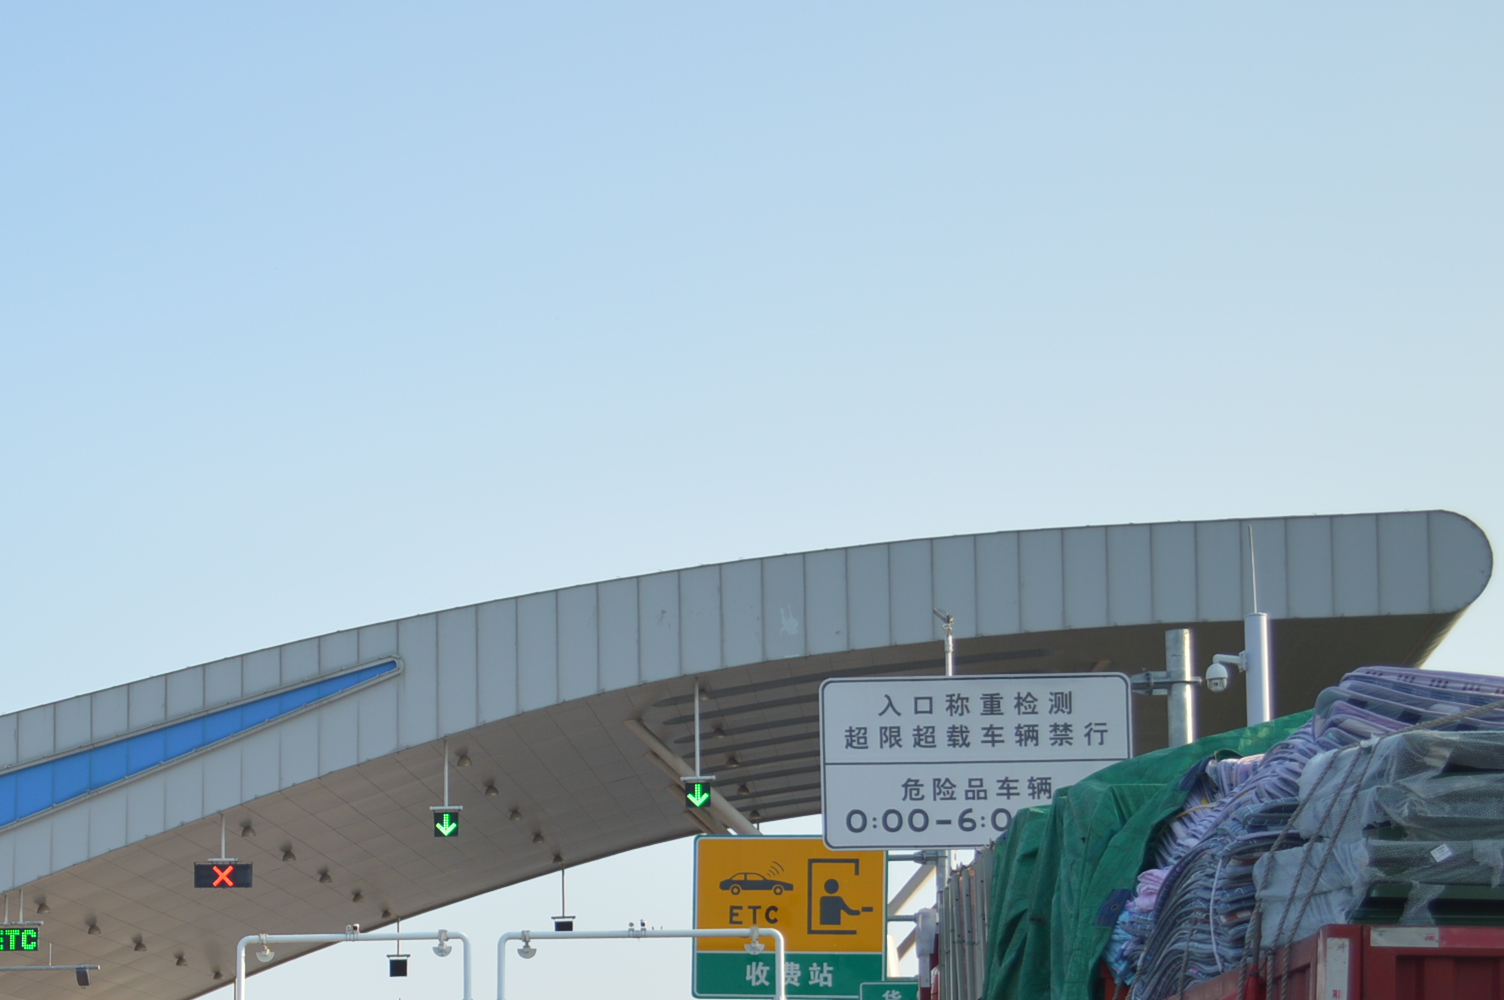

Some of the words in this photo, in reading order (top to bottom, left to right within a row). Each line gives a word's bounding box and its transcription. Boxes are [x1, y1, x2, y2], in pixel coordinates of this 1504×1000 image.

[877, 691, 1074, 717] 入口称重检测
[844, 721, 1110, 750] 超限超载车辆禁行
[901, 776, 1053, 802] 危险品车辆
[729, 905, 779, 925] ETC
[745, 960, 834, 987] 收费站
